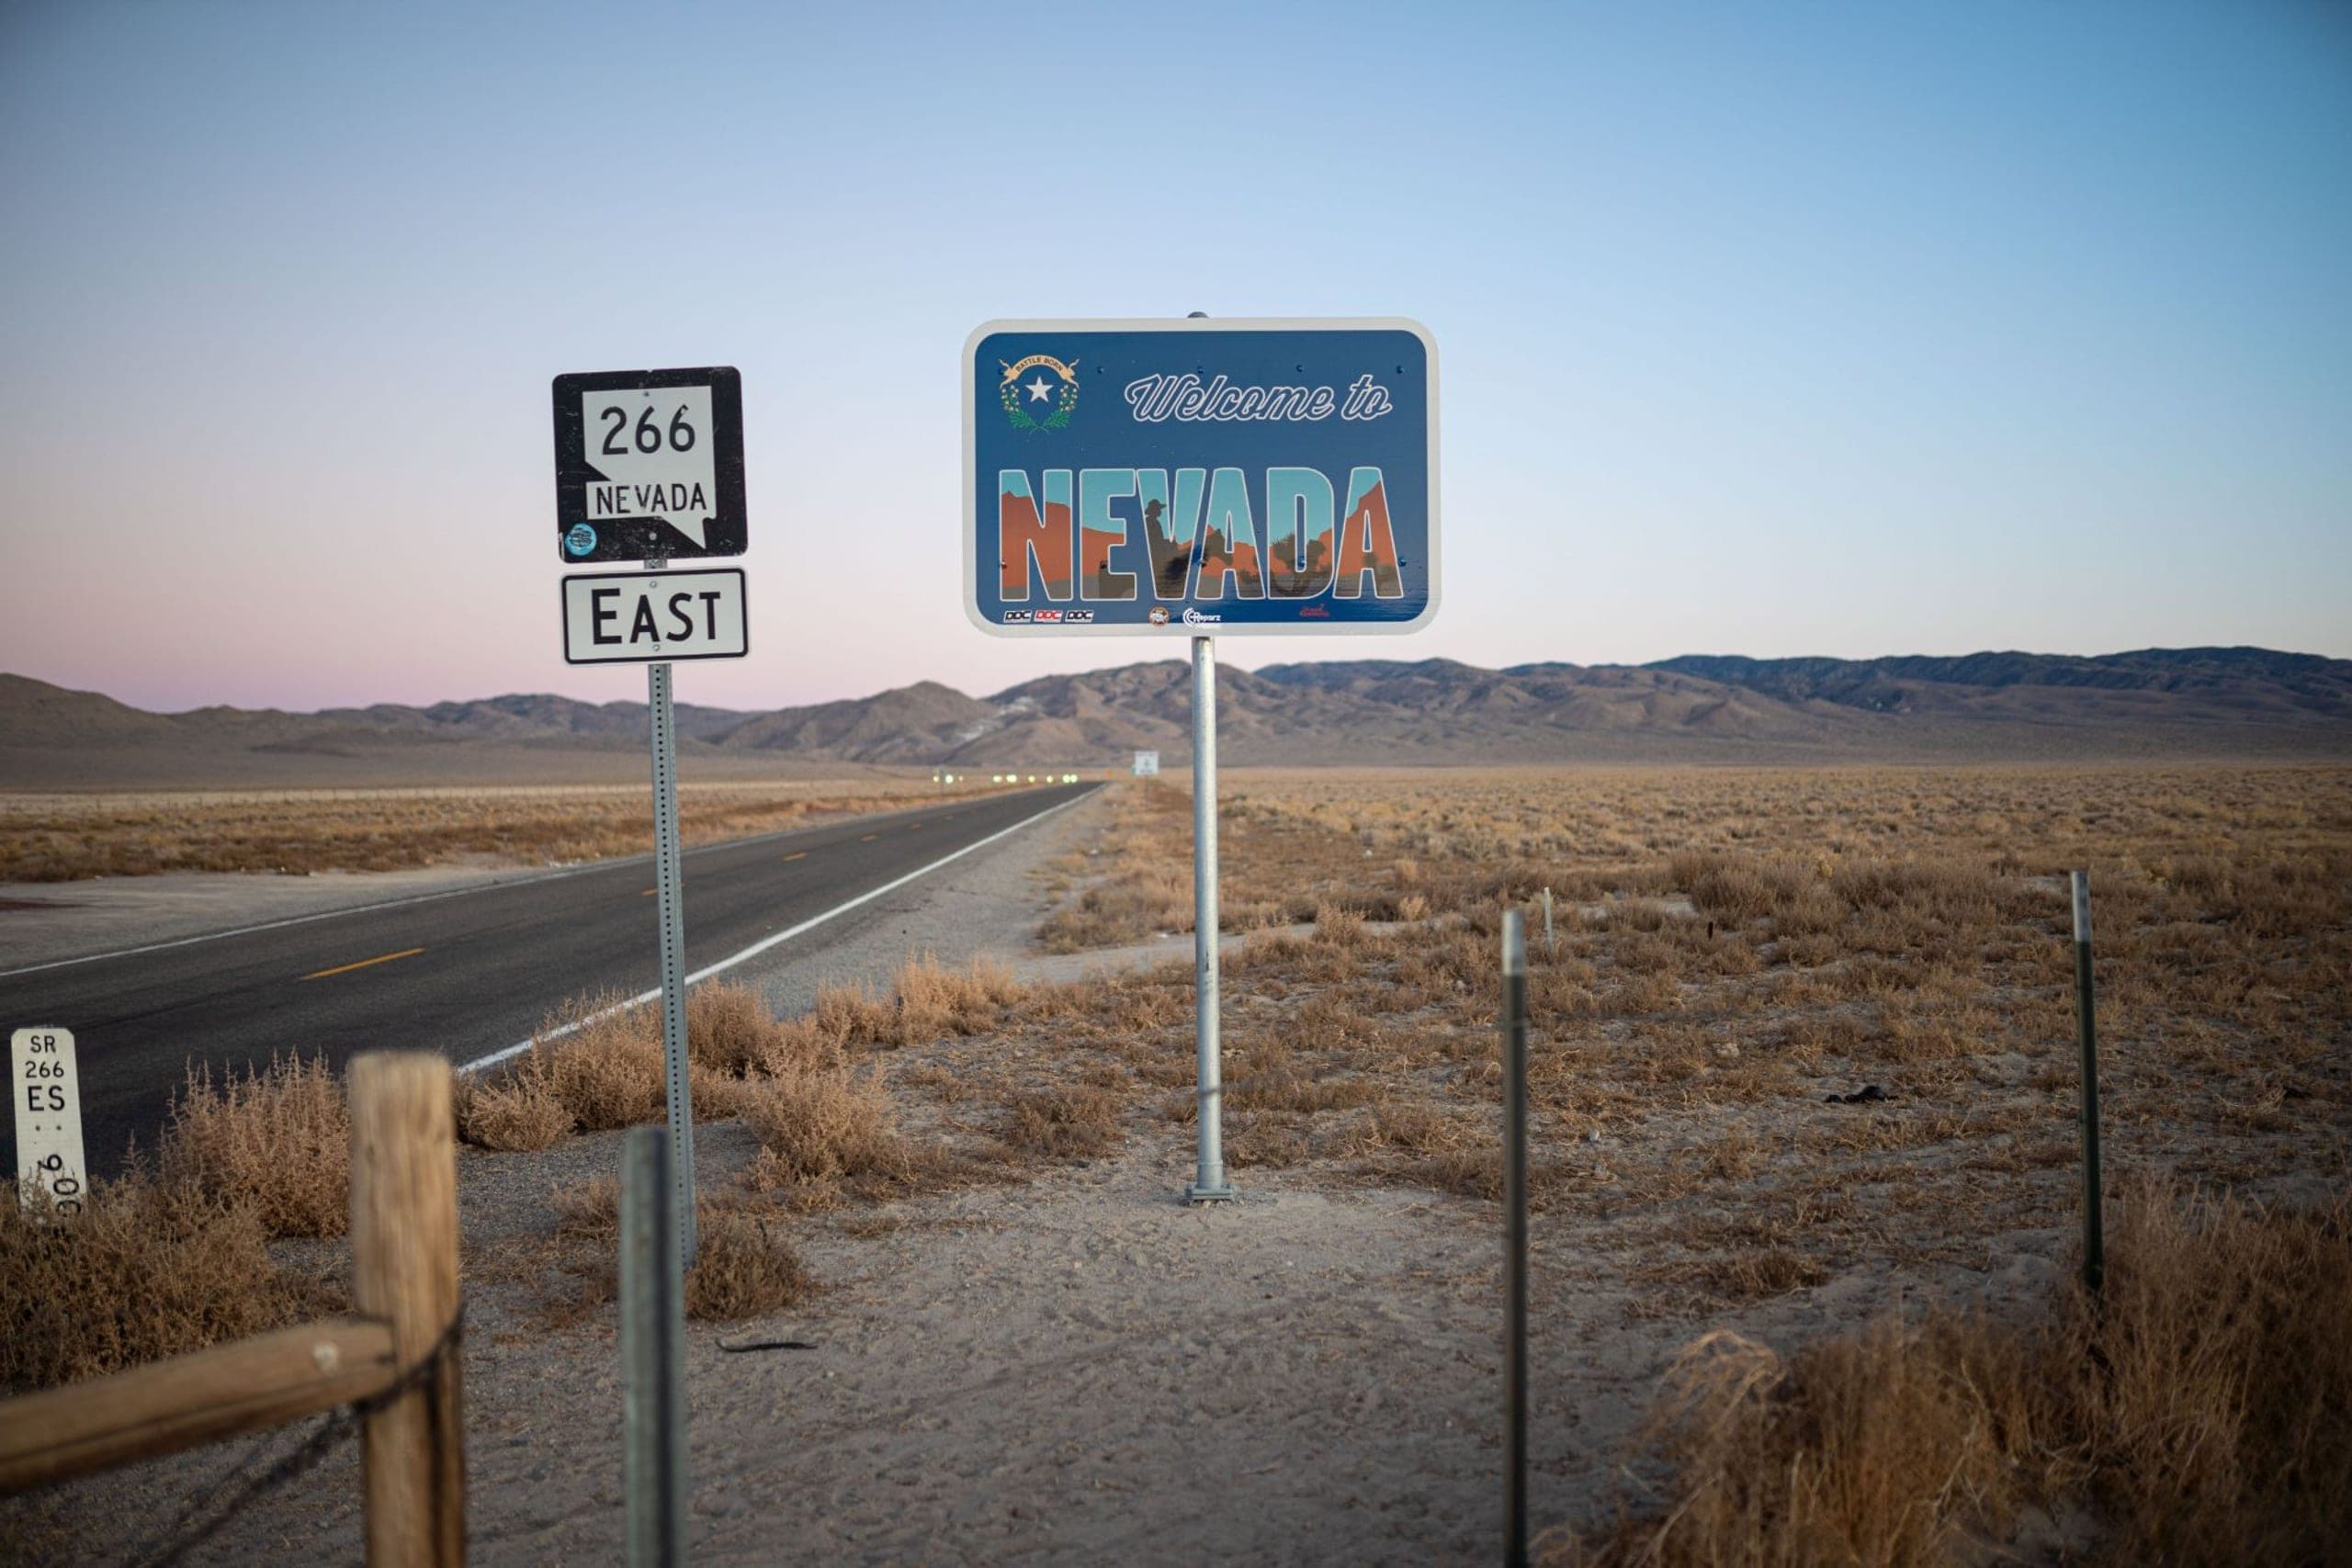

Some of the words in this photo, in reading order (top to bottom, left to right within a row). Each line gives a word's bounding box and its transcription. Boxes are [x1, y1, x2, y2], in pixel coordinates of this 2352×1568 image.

[1015, 355, 1041, 372] BATTLE
[1044, 357, 1064, 371] BORN
[1125, 373, 1335, 422] Welcome
[1341, 374, 1393, 421] to
[600, 404, 695, 456] 266
[595, 482, 707, 515] NEVADA
[999, 467, 1404, 602] NEVADA
[591, 587, 721, 645] EAST
[29, 1034, 57, 1054] SR
[25, 1060, 65, 1078] 266
[28, 1085, 66, 1111] ES
